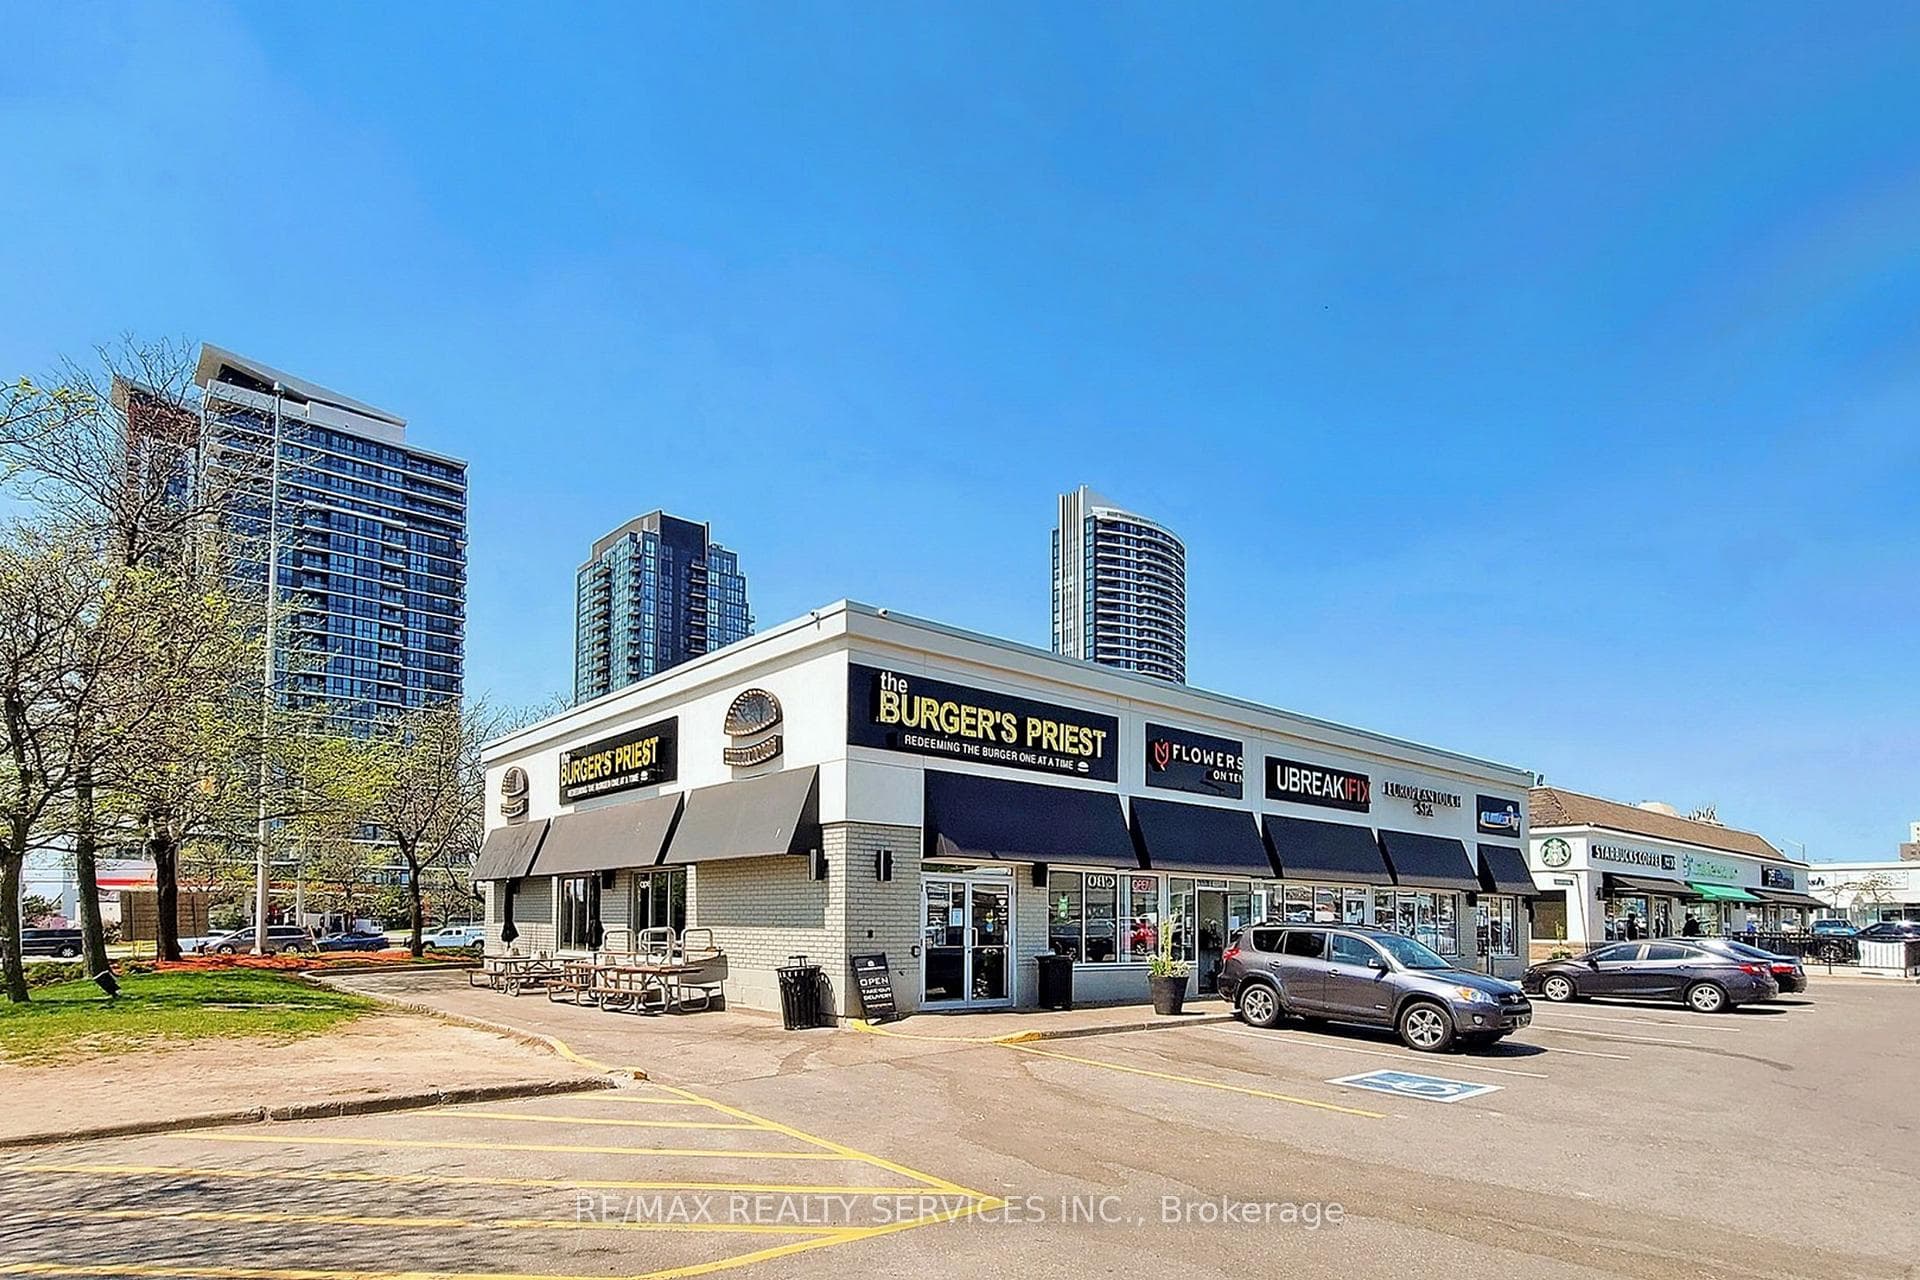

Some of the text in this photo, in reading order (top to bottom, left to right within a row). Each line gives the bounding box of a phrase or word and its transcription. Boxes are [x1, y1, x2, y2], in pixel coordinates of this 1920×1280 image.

[880, 671, 908, 693] the
[879, 689, 1107, 759] BURGER'S PRIEST
[560, 736, 659, 787] BURGER'S PRIEST
[904, 734, 960, 753] REDEEMING
[962, 743, 980, 756] THE
[982, 746, 1018, 761] BURGER
[1019, 752, 1036, 764] ONE
[1037, 755, 1048, 765] AT
[1055, 758, 1074, 770] TIME
[1172, 743, 1244, 771] FLOWERS
[1213, 770, 1226, 781] ON
[1276, 764, 1372, 804] UBREAKIFIX
[859, 976, 889, 987] OPEN
